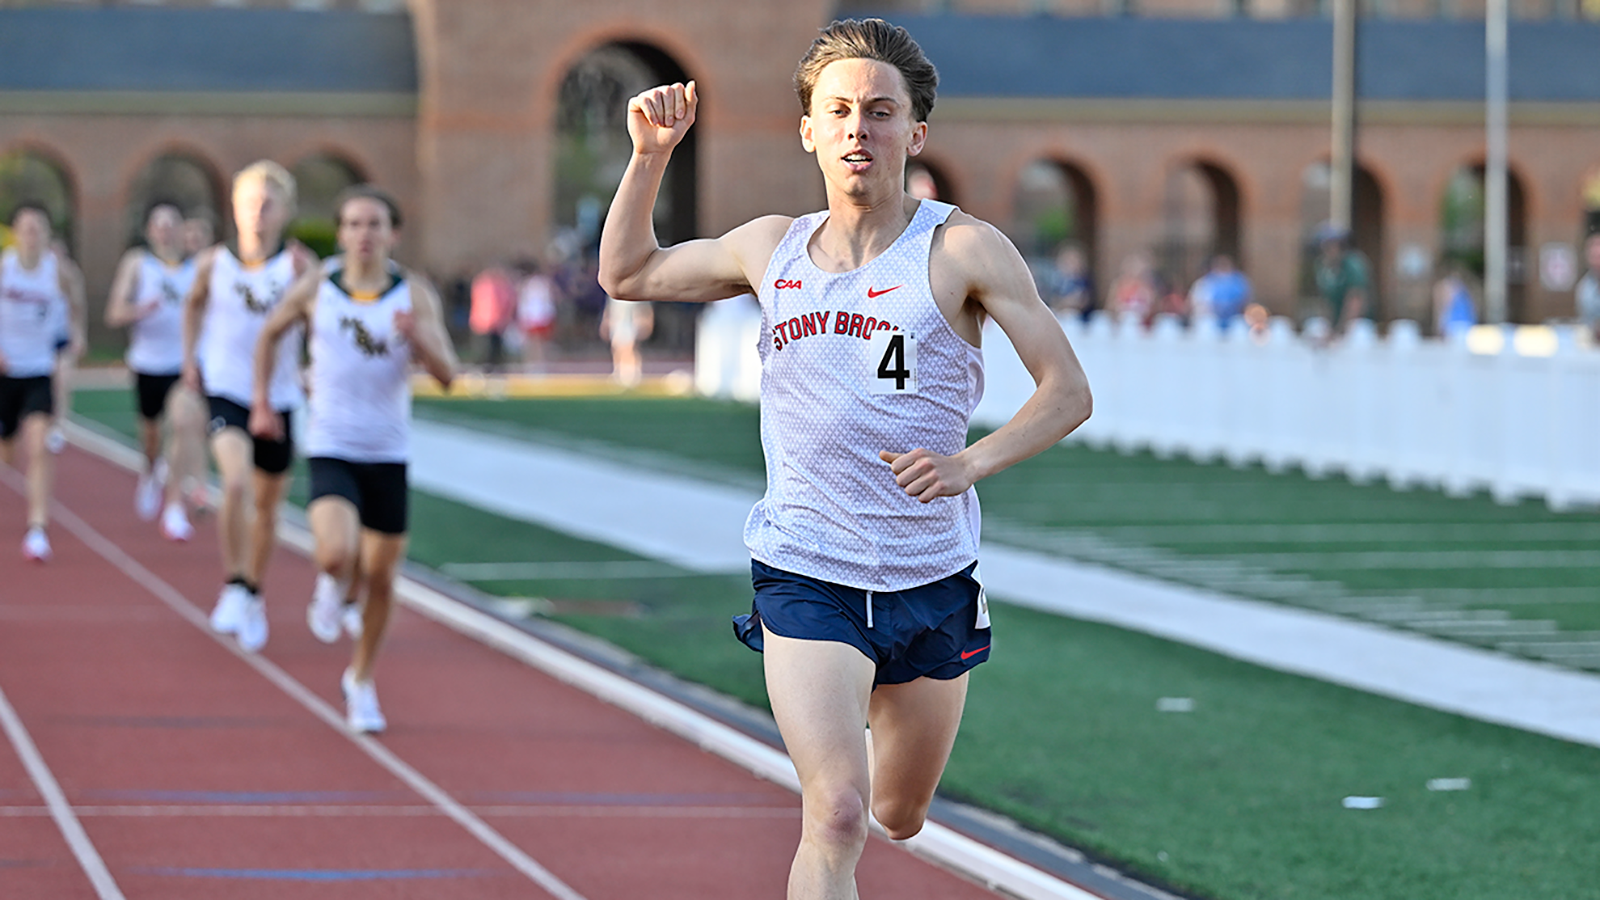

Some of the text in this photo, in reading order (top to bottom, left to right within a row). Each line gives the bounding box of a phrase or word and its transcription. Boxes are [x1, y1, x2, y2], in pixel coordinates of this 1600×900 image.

[774, 279, 802, 290] CAA
[834, 311, 904, 341] BRO
[877, 335, 910, 390] 4
